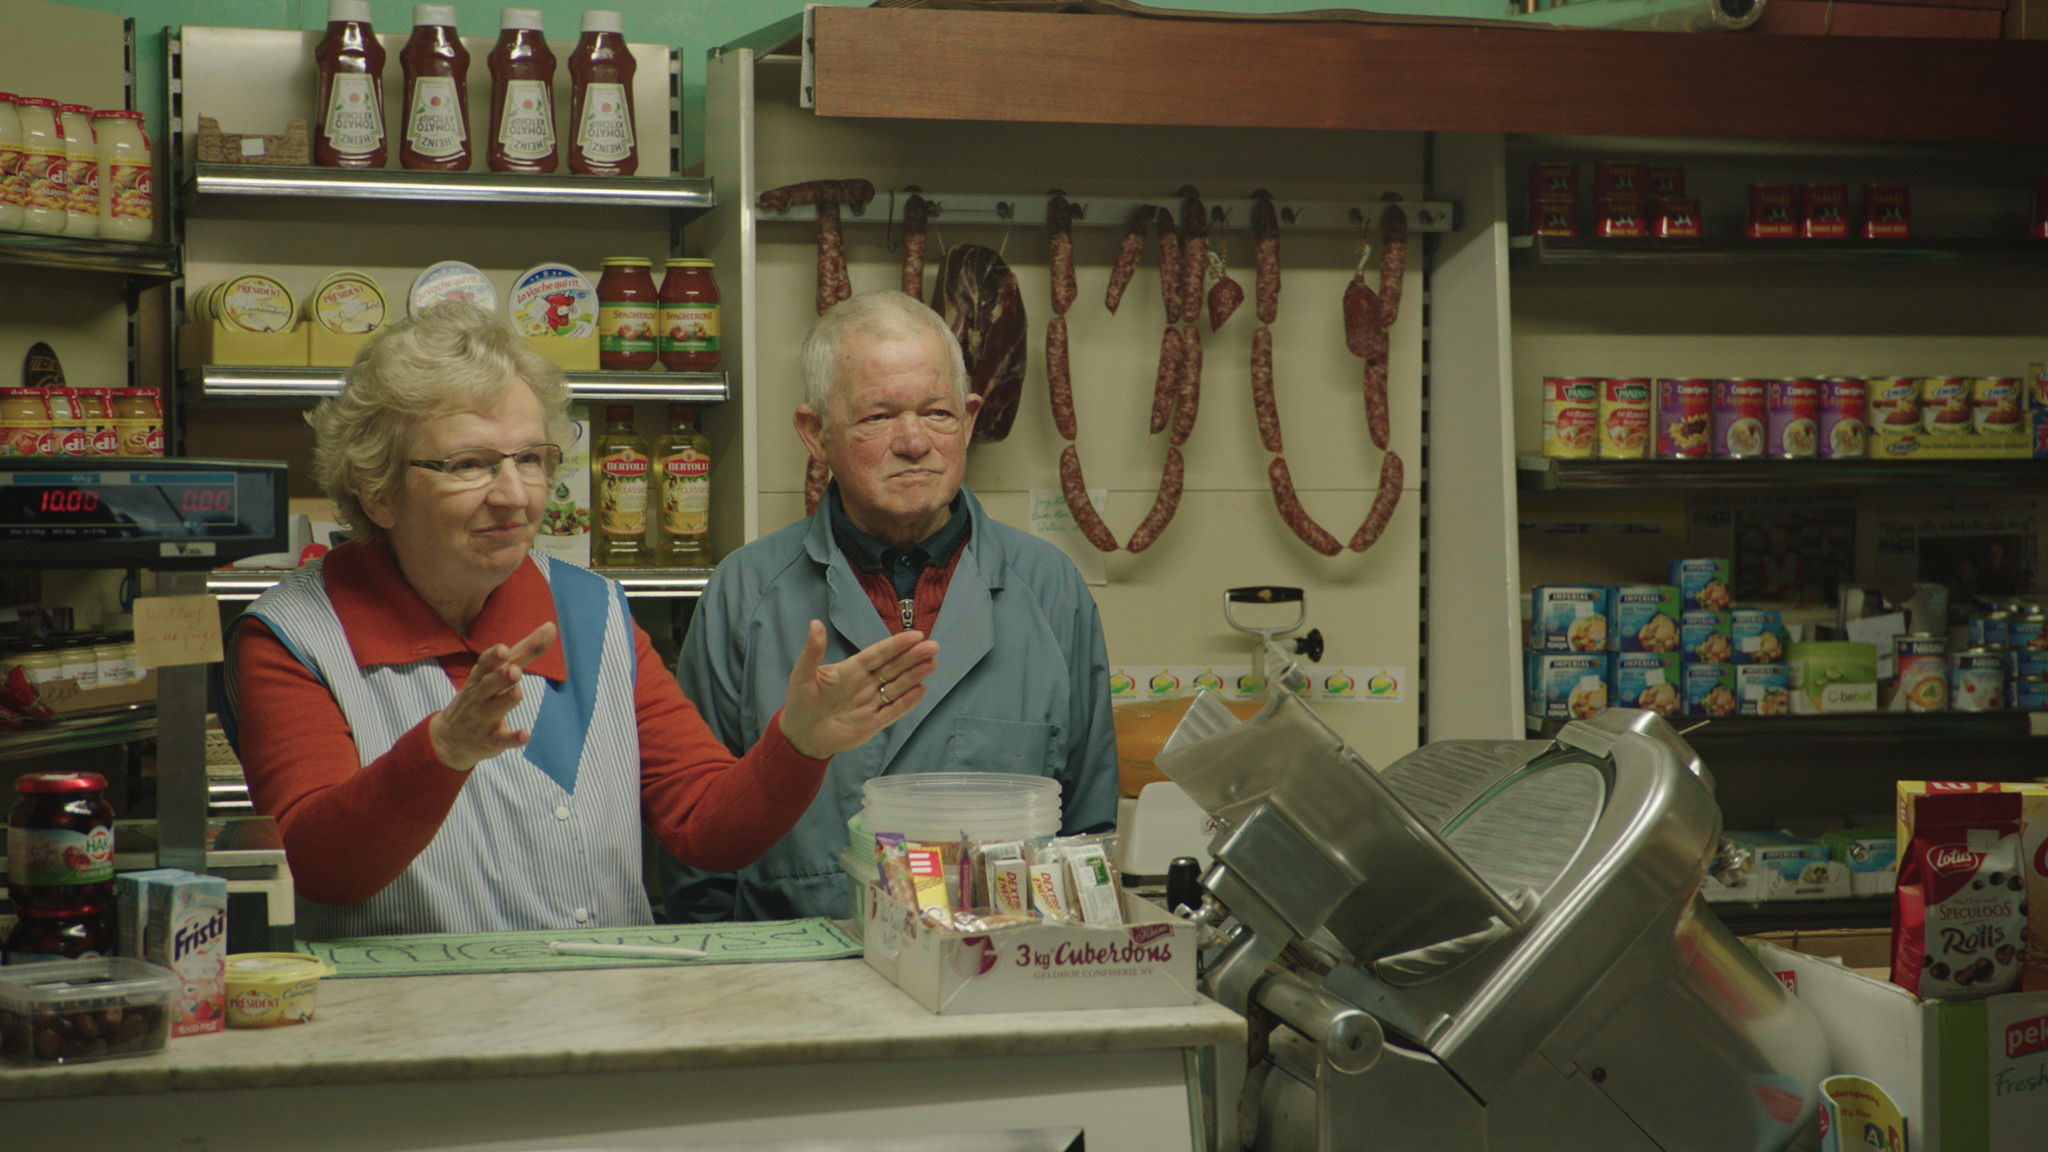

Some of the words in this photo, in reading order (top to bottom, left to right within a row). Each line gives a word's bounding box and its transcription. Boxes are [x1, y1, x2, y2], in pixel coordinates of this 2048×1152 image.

[337, 112, 372, 120] KETCHUP
[418, 114, 453, 123] KETCHUP
[336, 120, 374, 129] TOMATO
[416, 122, 456, 132] TOMATO
[510, 118, 545, 126] KETCHUP
[590, 120, 623, 128] KETCHUP
[509, 126, 546, 135] TOMATO
[588, 128, 625, 138] TOMATO
[340, 134, 370, 144] HEINZ
[421, 136, 454, 148] HEINZ
[514, 139, 543, 150] HEINZ
[592, 142, 622, 153] HEINZ
[1552, 592, 1589, 600] IMPERIAL
[1624, 594, 1660, 602] IMPERIAL
[1553, 660, 1590, 668] IMPERIAL
[1624, 660, 1660, 668] IMPERIAL
[1936, 850, 1972, 868] Lotus
[1939, 902, 2012, 920] SPECULOOS
[174, 908, 224, 962] Fristi
[1940, 924, 2006, 954] Rolls
[1016, 944, 1031, 967] 3
[1034, 950, 1051, 970] kg
[1054, 940, 1172, 966] Cuberdons
[1082, 968, 1139, 978] CONFISERIE
